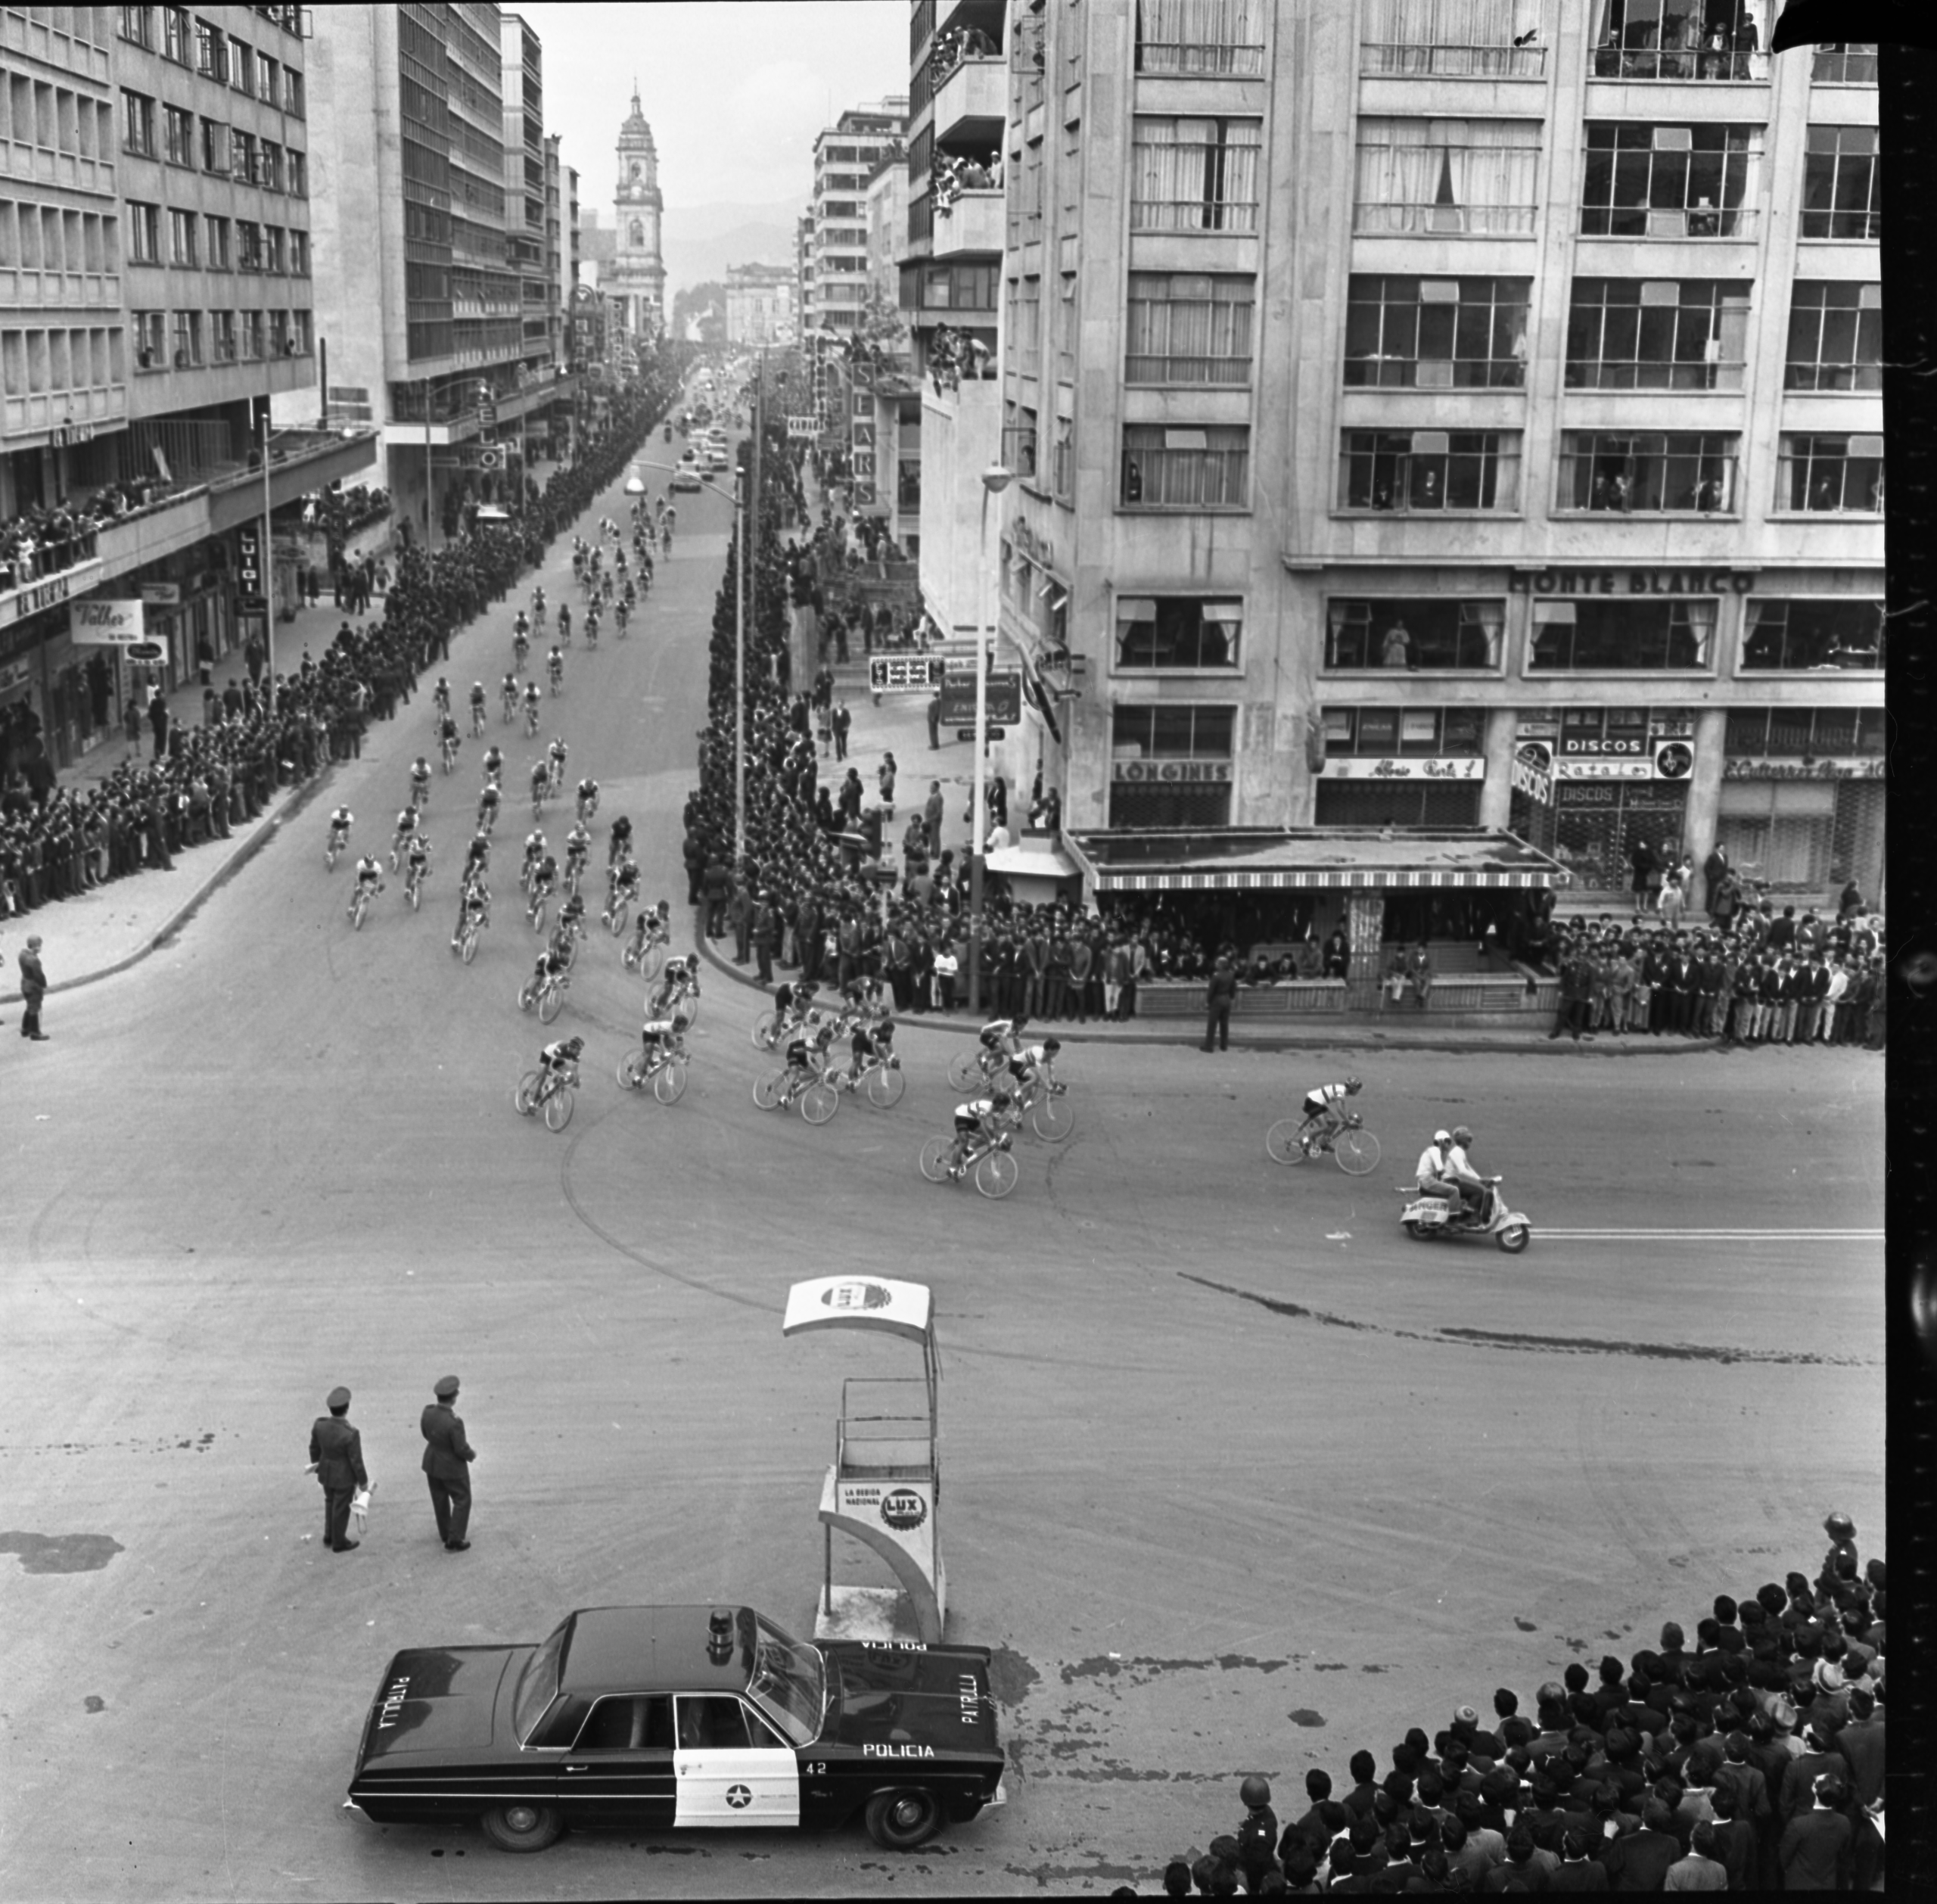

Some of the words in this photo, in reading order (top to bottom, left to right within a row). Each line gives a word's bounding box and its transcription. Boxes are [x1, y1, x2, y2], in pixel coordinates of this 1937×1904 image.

[857, 366, 872, 502] SEARS
[1508, 571, 1615, 594] MONTE
[1628, 571, 1755, 594] BLANCO
[1566, 739, 1641, 752] DISCOS
[1115, 761, 1227, 781] LONGINES
[1562, 786, 1613, 801] DISCOS
[844, 1488, 854, 1496] LA
[886, 1498, 917, 1511] LUX
[863, 1743, 935, 1758] POLICIA
[805, 1762, 827, 1775] 42
